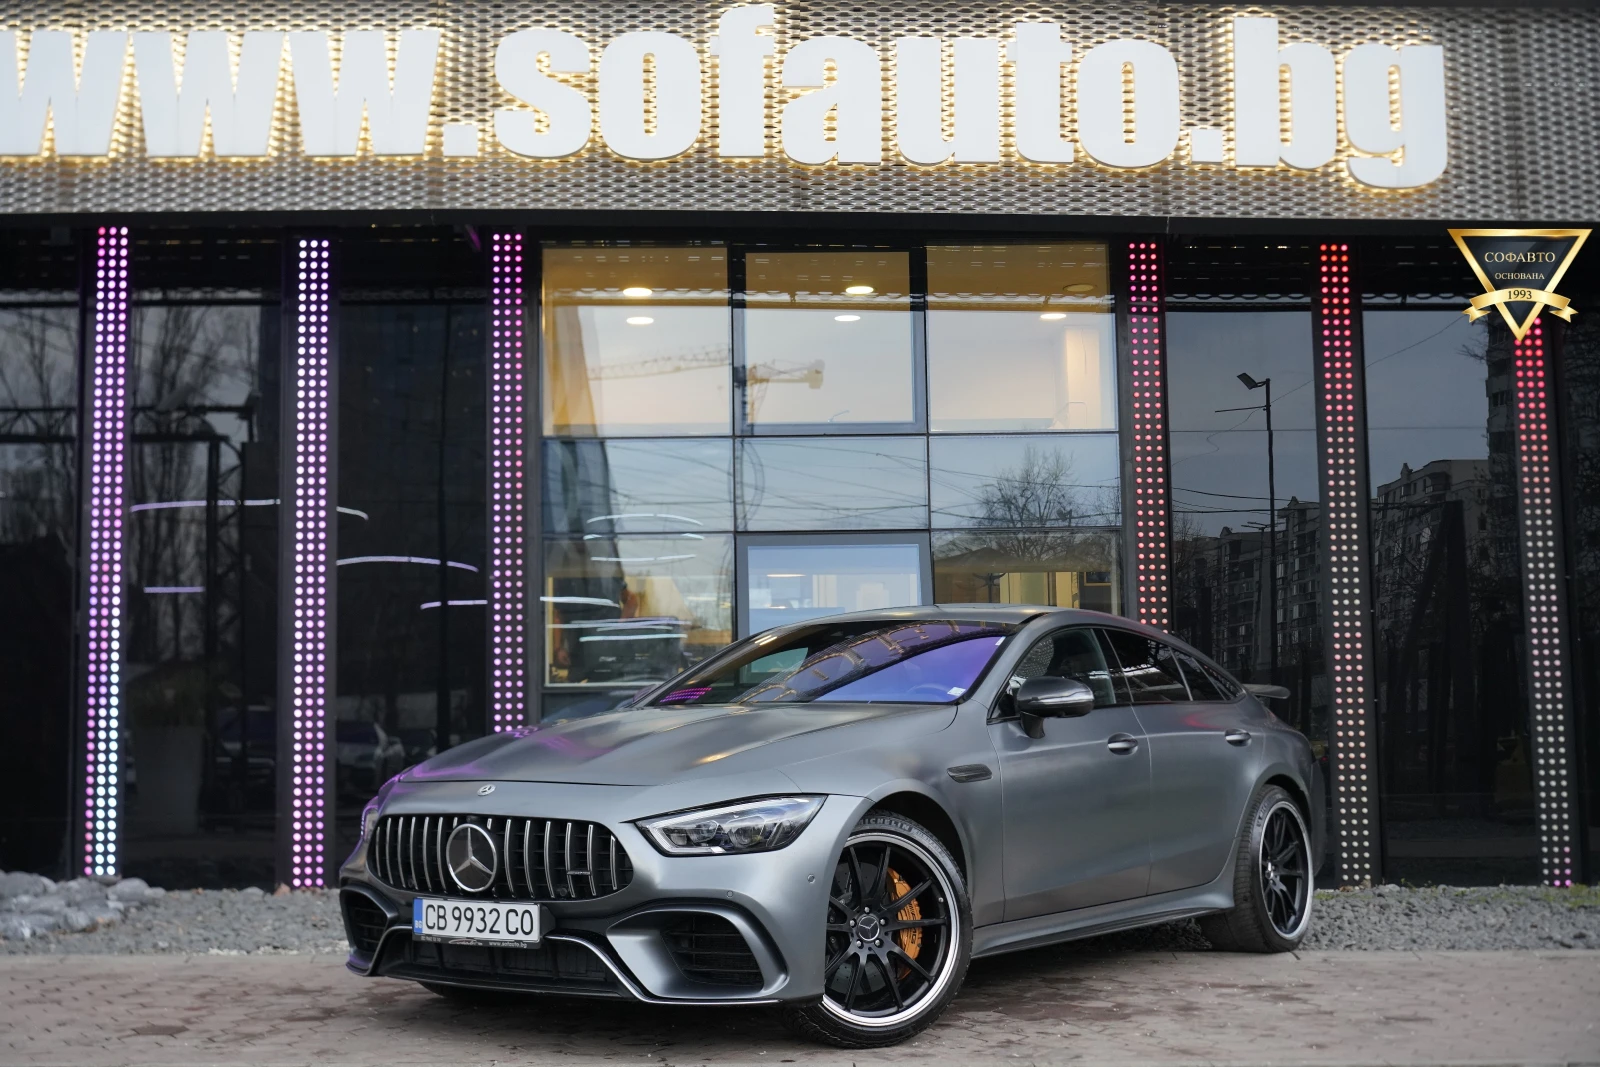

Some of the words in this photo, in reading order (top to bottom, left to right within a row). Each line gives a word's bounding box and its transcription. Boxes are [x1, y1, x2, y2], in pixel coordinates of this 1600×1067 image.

[0, 4, 1448, 189] www.sofauto.bg
[425, 904, 448, 931] CB
[451, 906, 501, 934] 9932
